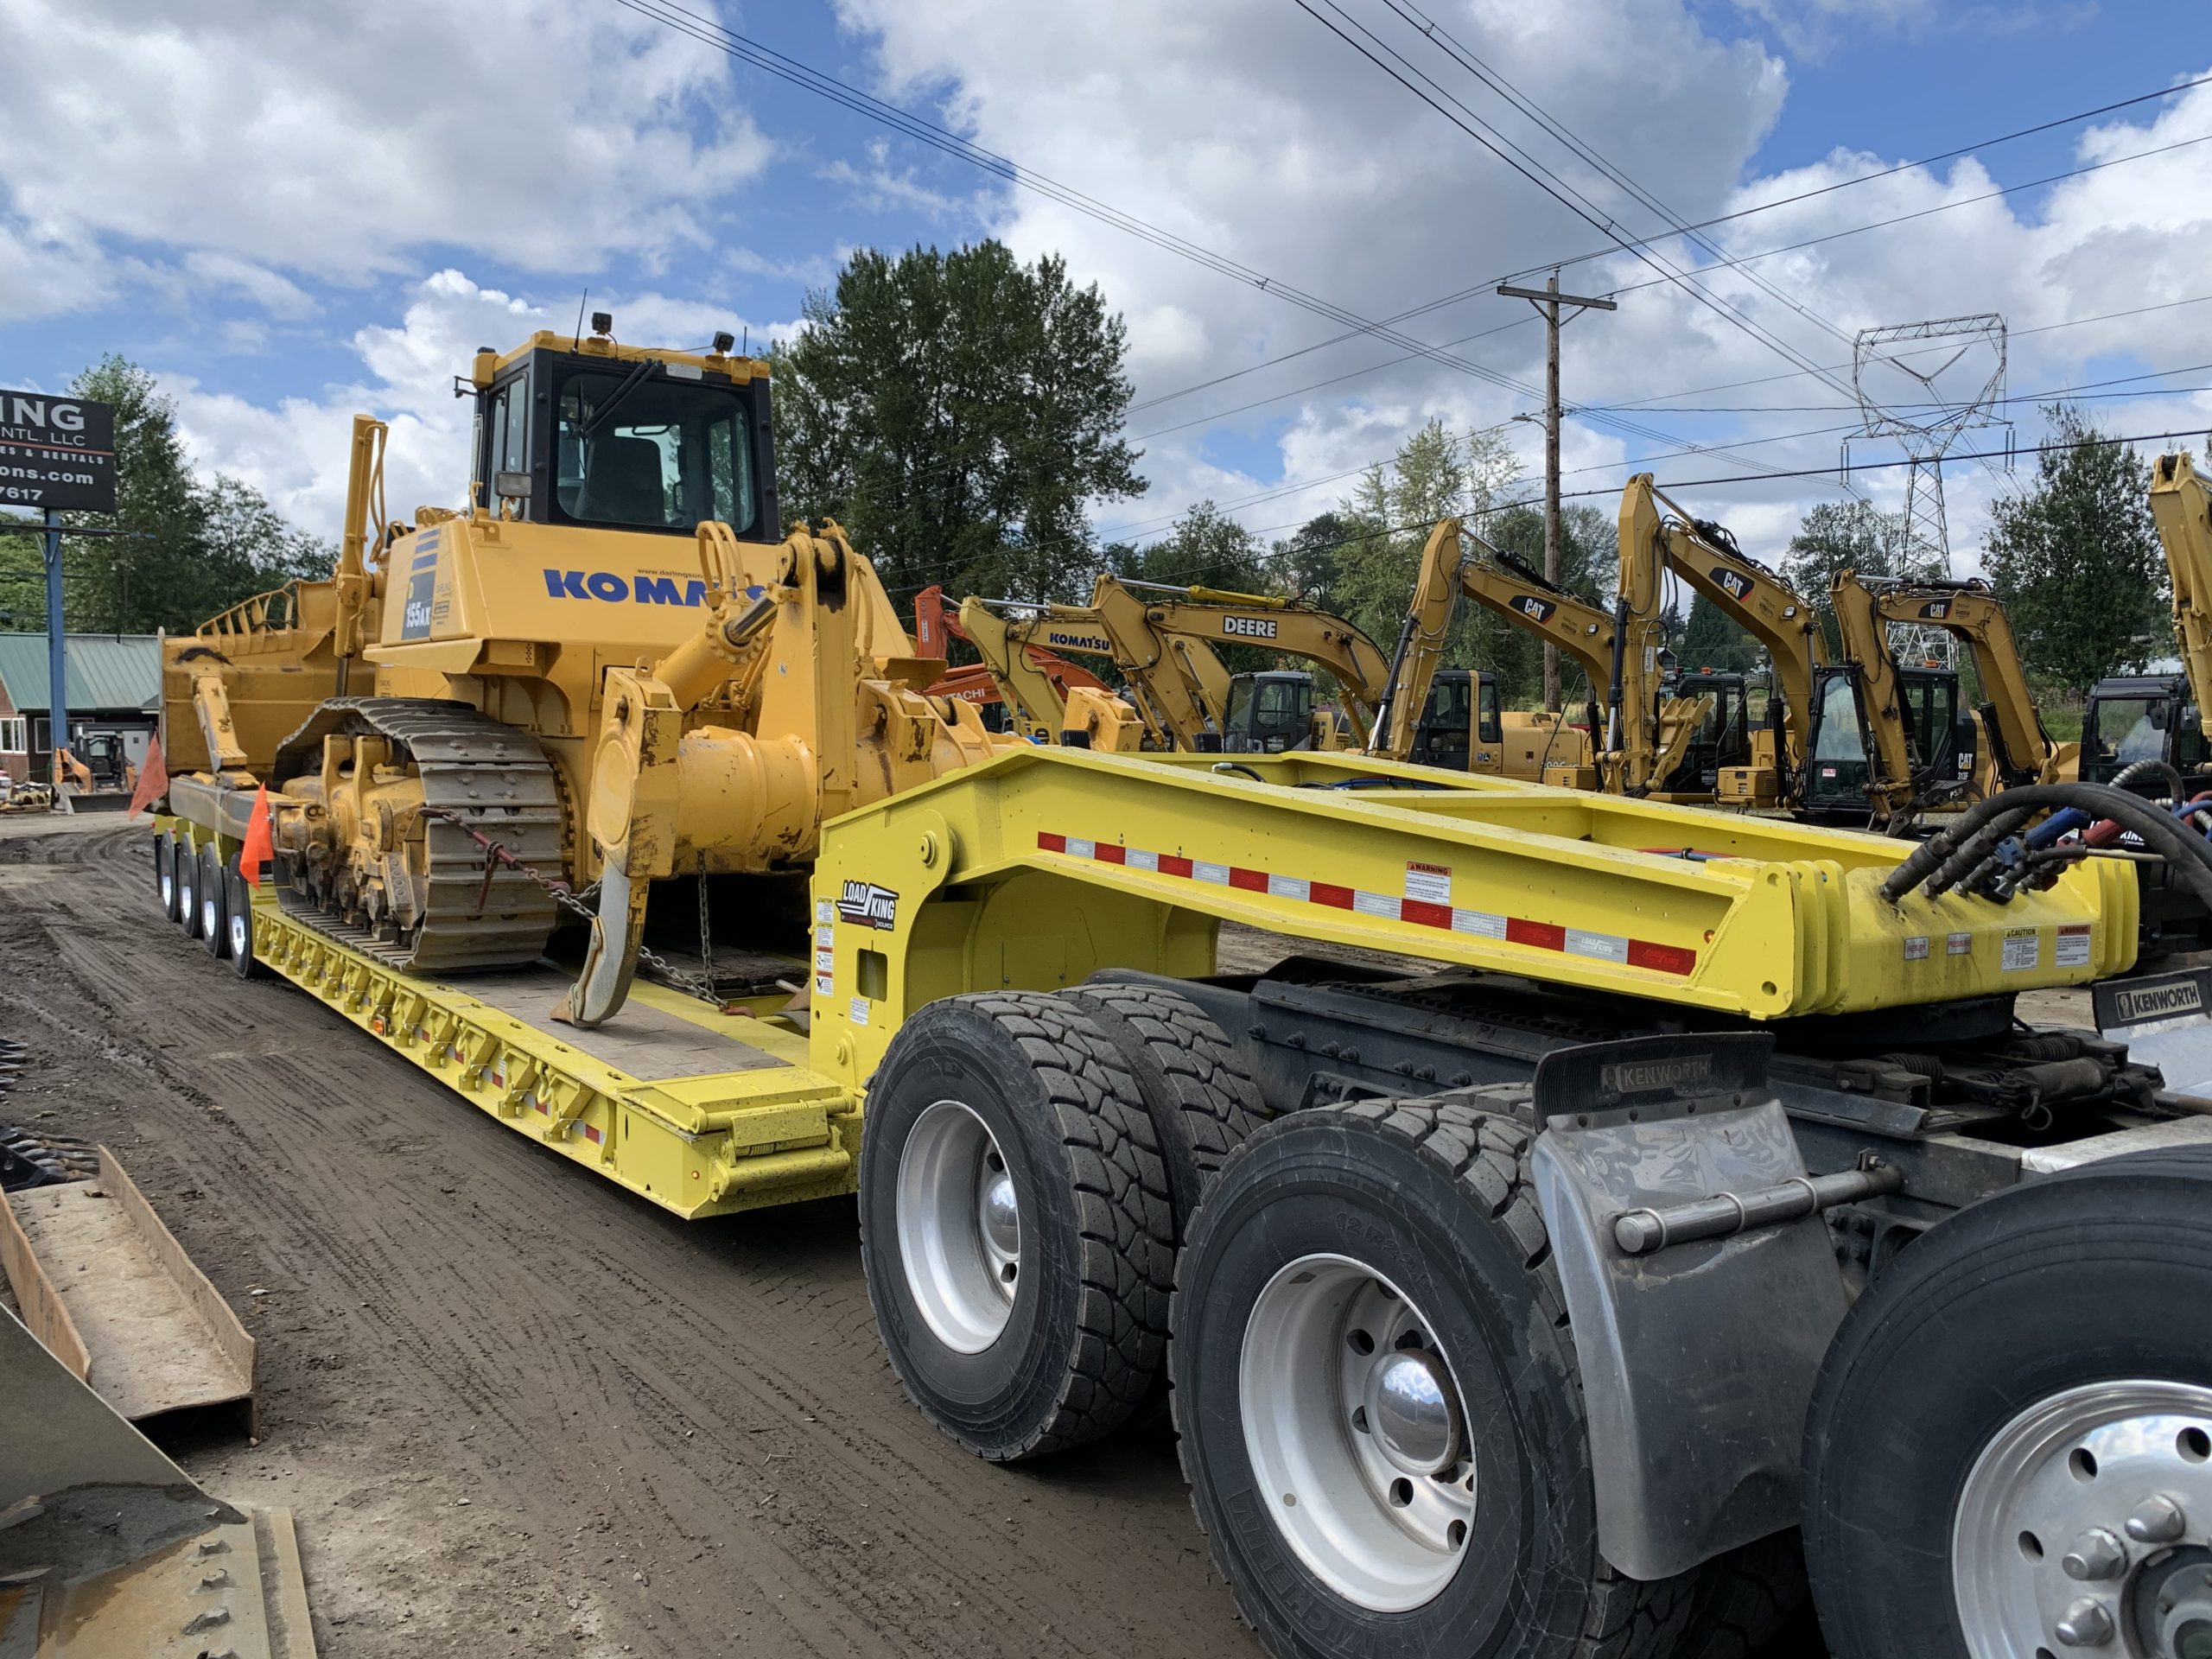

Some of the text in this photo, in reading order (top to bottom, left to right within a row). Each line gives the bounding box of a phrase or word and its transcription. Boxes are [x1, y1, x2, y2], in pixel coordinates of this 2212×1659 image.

[51, 432, 86, 447] LLC
[25, 448, 34, 457] &
[42, 450, 104, 465] RENTALS
[0, 466, 93, 485] ons.com
[1724, 571, 1744, 598] CAT
[406, 601, 431, 628] 155AX
[1524, 598, 1545, 621] CAT
[1929, 603, 1945, 619] CAT
[1224, 616, 1277, 638] DEERE
[1049, 632, 1110, 651] KOMATSU
[941, 688, 985, 700] TACHI
[1958, 752, 1974, 770] CAT
[1957, 772, 1969, 781] 313F
[2120, 830, 2145, 842] KIN
[1415, 863, 1448, 875] WARNING
[842, 882, 867, 903] LOAD
[870, 897, 895, 920] KING
[1580, 937, 1597, 946] LOAD
[2011, 928, 2036, 937] CAUTION
[1906, 944, 1926, 952] RETURN
[2133, 985, 2198, 1014] KENWORTH
[1624, 1060, 1708, 1087] KENWORTH
